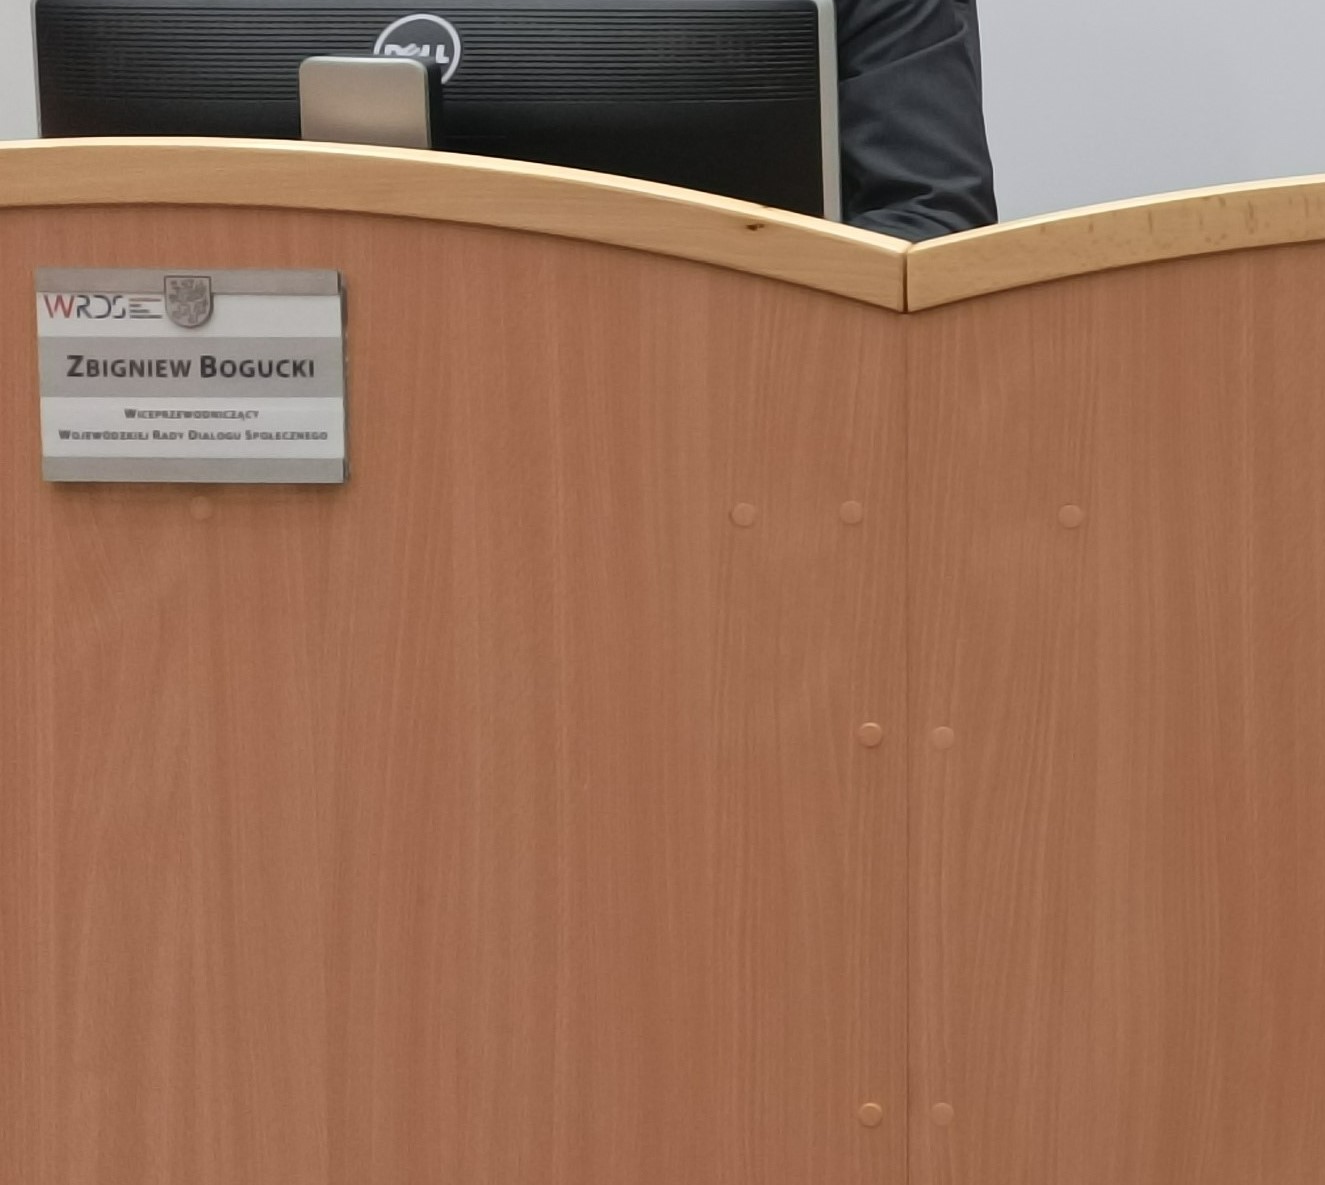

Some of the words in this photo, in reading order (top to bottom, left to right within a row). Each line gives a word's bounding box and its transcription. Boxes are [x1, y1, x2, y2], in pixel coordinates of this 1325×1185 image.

[43, 294, 126, 319] WRDS
[67, 355, 191, 377] ZBIGNIEW
[200, 355, 315, 378] BOGUCKI
